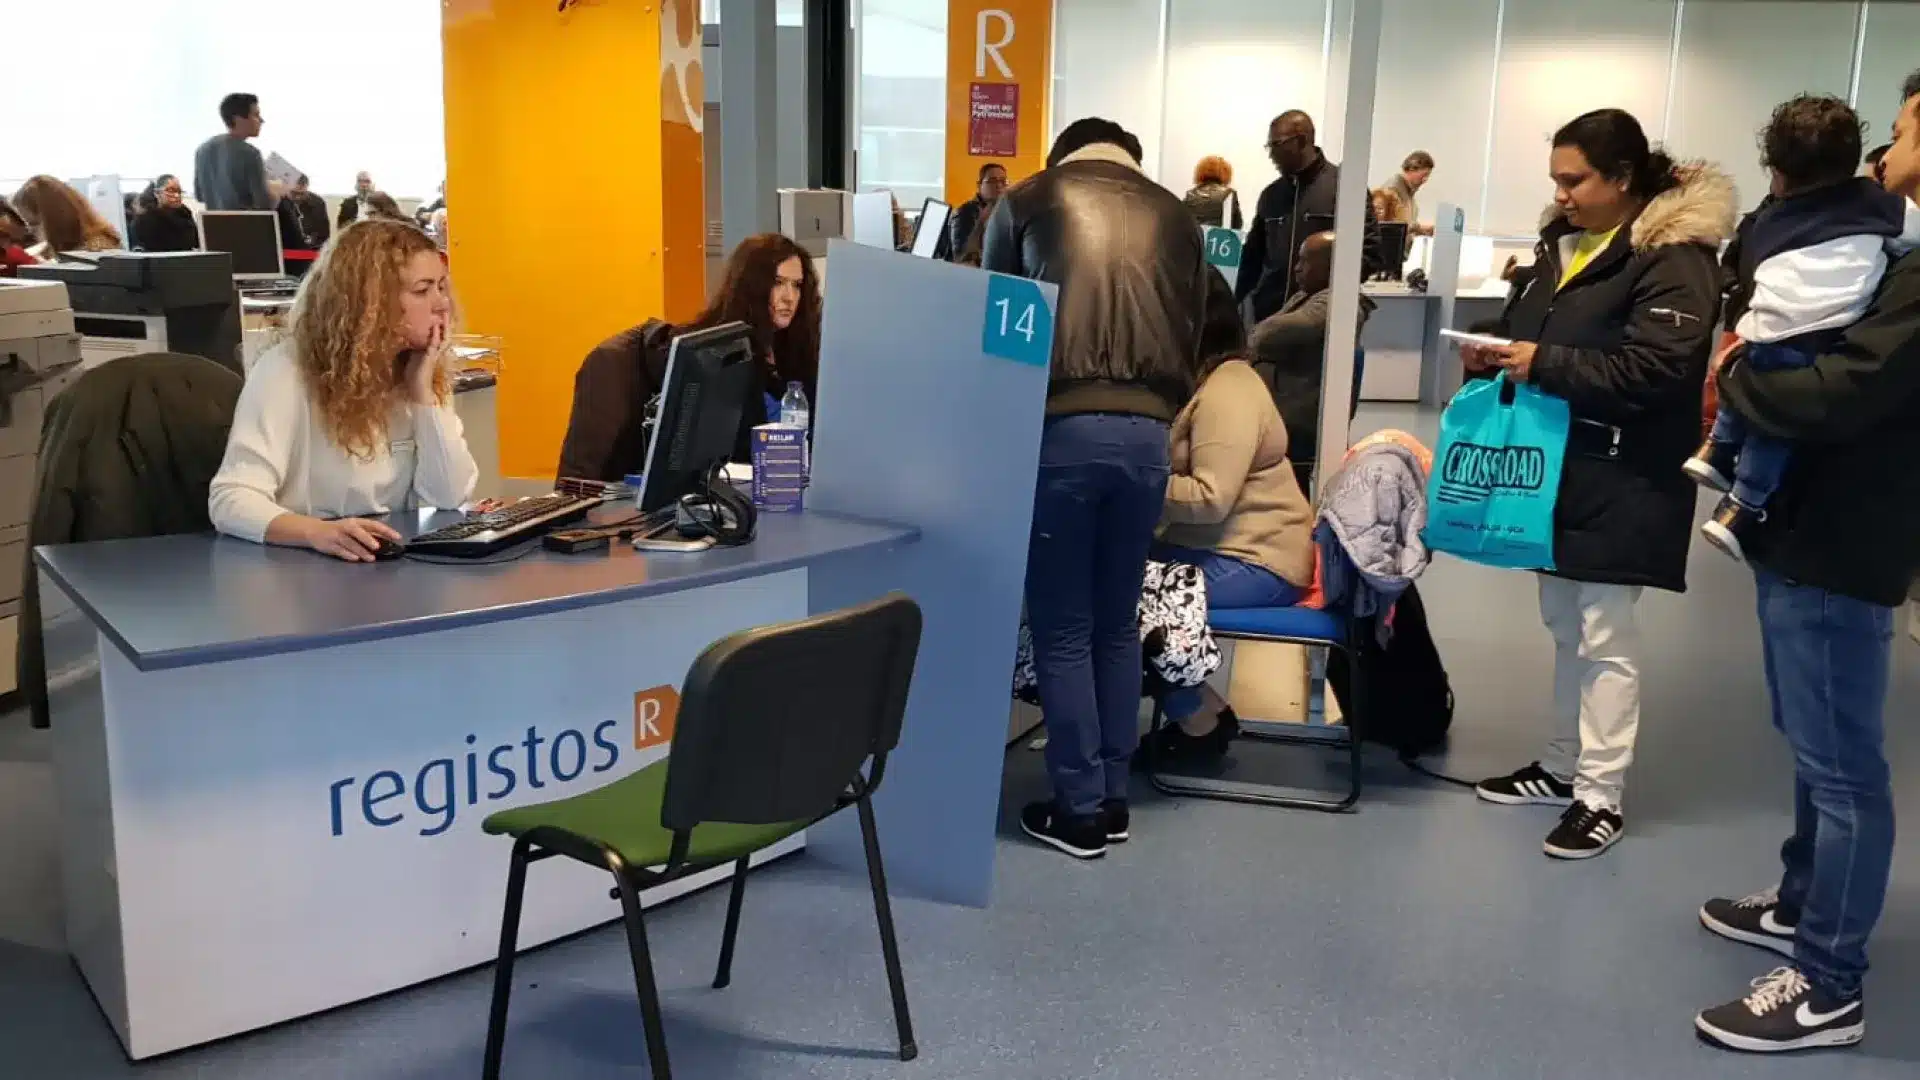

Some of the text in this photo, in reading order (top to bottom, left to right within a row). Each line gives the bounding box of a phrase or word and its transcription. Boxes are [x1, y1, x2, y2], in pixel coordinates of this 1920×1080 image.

[976, 9, 1015, 78] R
[1209, 237, 1230, 257] 16
[995, 298, 1035, 341] 14
[330, 698, 661, 836] registos R
